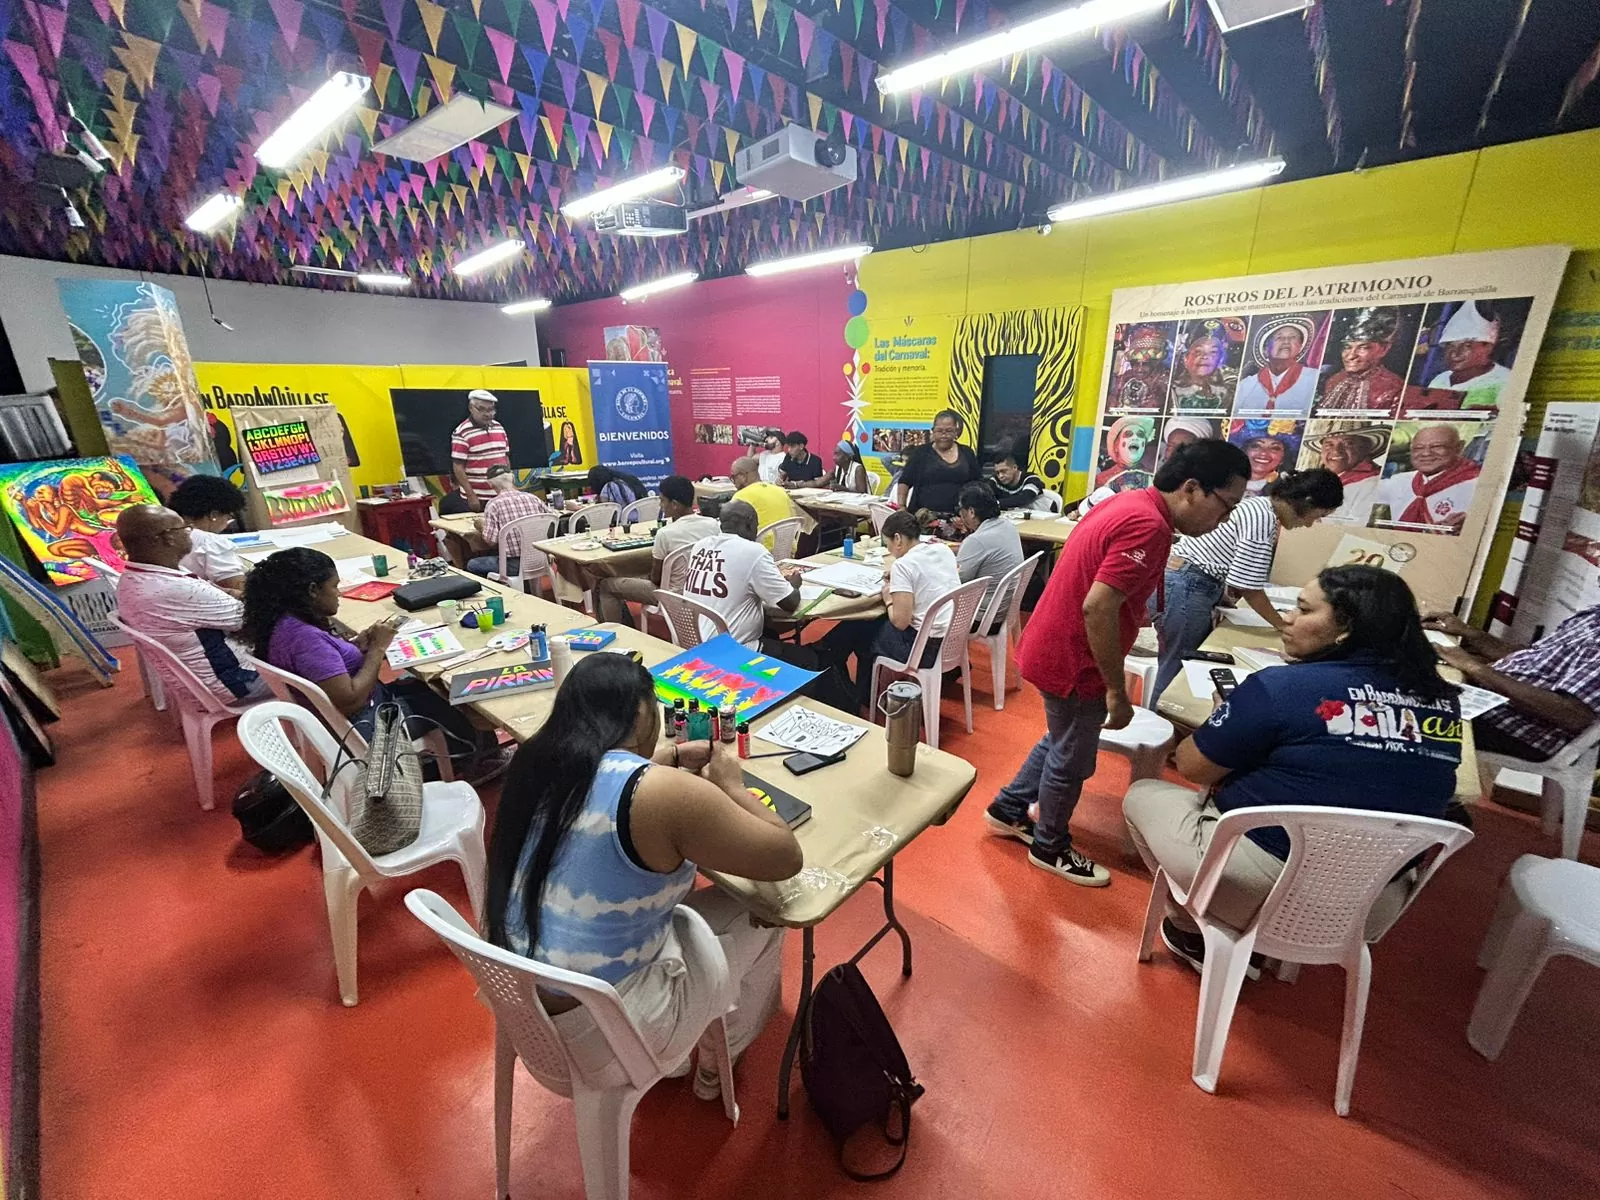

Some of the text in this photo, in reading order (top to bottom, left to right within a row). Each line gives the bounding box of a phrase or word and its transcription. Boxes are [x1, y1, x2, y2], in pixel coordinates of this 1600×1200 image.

[1184, 275, 1432, 307] ROSTROS DEL PATRIMONIO
[1150, 309, 1181, 319] homenaje
[1196, 305, 1232, 315] portadores
[1233, 304, 1246, 313] que
[1248, 302, 1286, 310] mantienen
[1306, 298, 1316, 306] las
[1319, 294, 1364, 304] tradiciones
[1366, 293, 1379, 301] del
[1381, 290, 1422, 300] Carnaval
[1424, 289, 1435, 297] de
[1438, 284, 1498, 297] Barranquilla
[874, 334, 937, 349] Las Máscaras
[874, 350, 888, 362] del
[874, 365, 897, 373] Tradición
[246, 423, 306, 441] ABCDEFGH
[599, 430, 669, 442] BIENVENIDOS
[696, 548, 721, 559] ART
[692, 555, 725, 572] THAT
[501, 665, 528, 675] LA
[739, 655, 781, 681] LA
[460, 667, 553, 695] PIRRIN
[1347, 686, 1366, 701] EN
